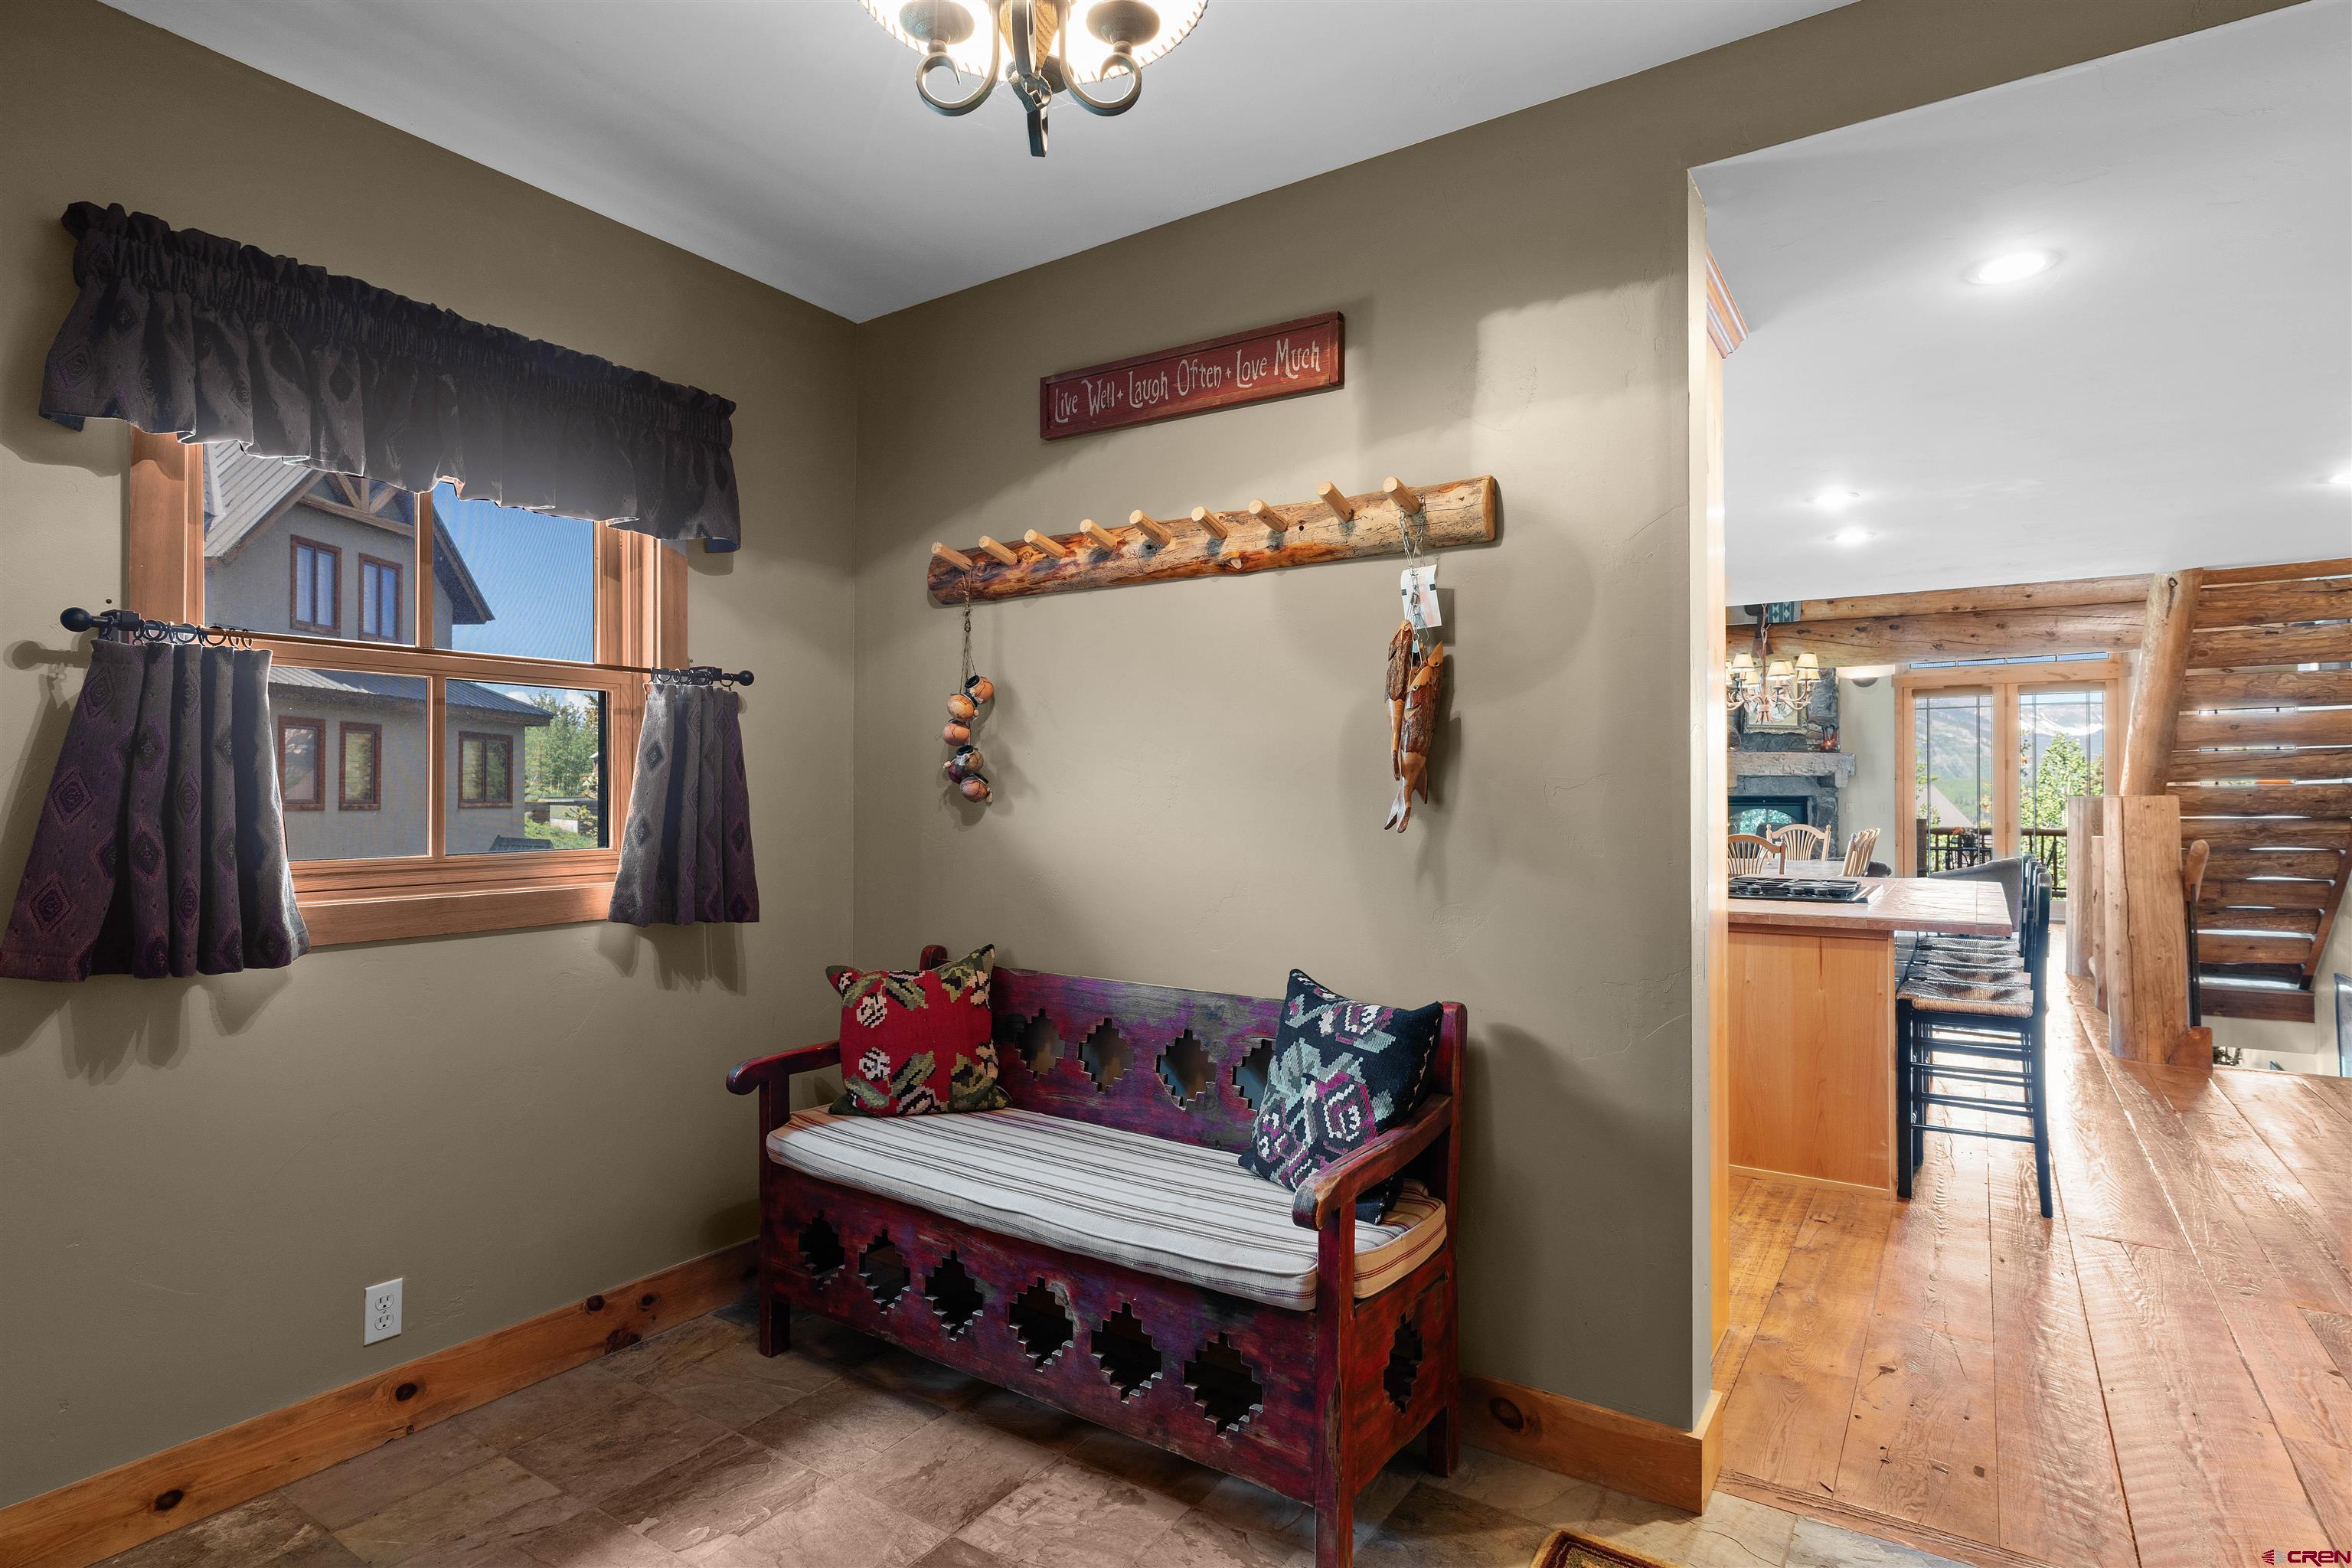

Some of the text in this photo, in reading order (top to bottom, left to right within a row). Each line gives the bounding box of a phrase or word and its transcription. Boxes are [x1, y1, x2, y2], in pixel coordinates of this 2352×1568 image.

[1054, 338, 1321, 423] Live Well Laugh Often Love Much
